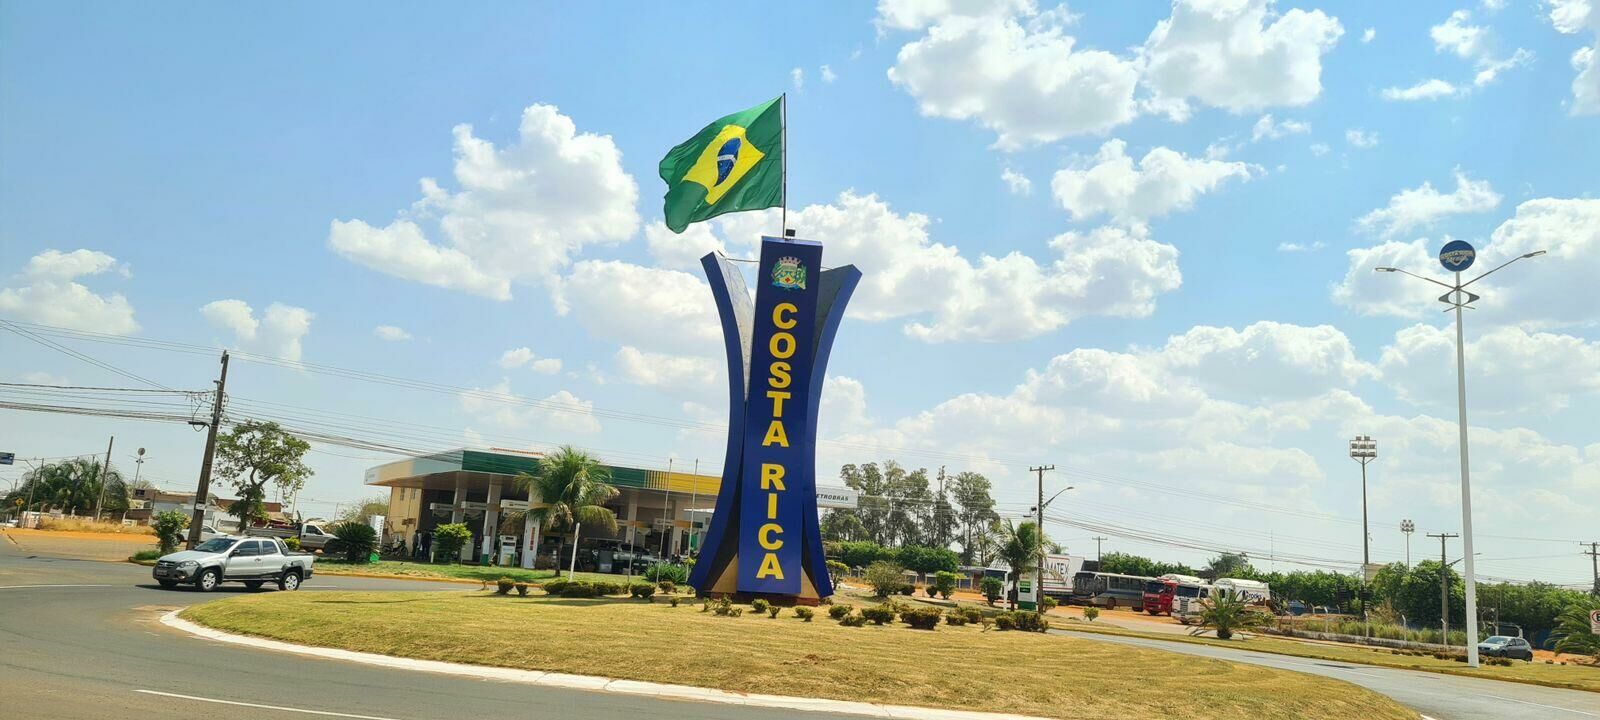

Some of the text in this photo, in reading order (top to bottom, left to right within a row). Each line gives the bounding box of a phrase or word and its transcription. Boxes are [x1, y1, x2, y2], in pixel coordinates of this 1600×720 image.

[756, 303, 798, 580] COSTA RICA
[816, 493, 849, 502] ETROBRAS
